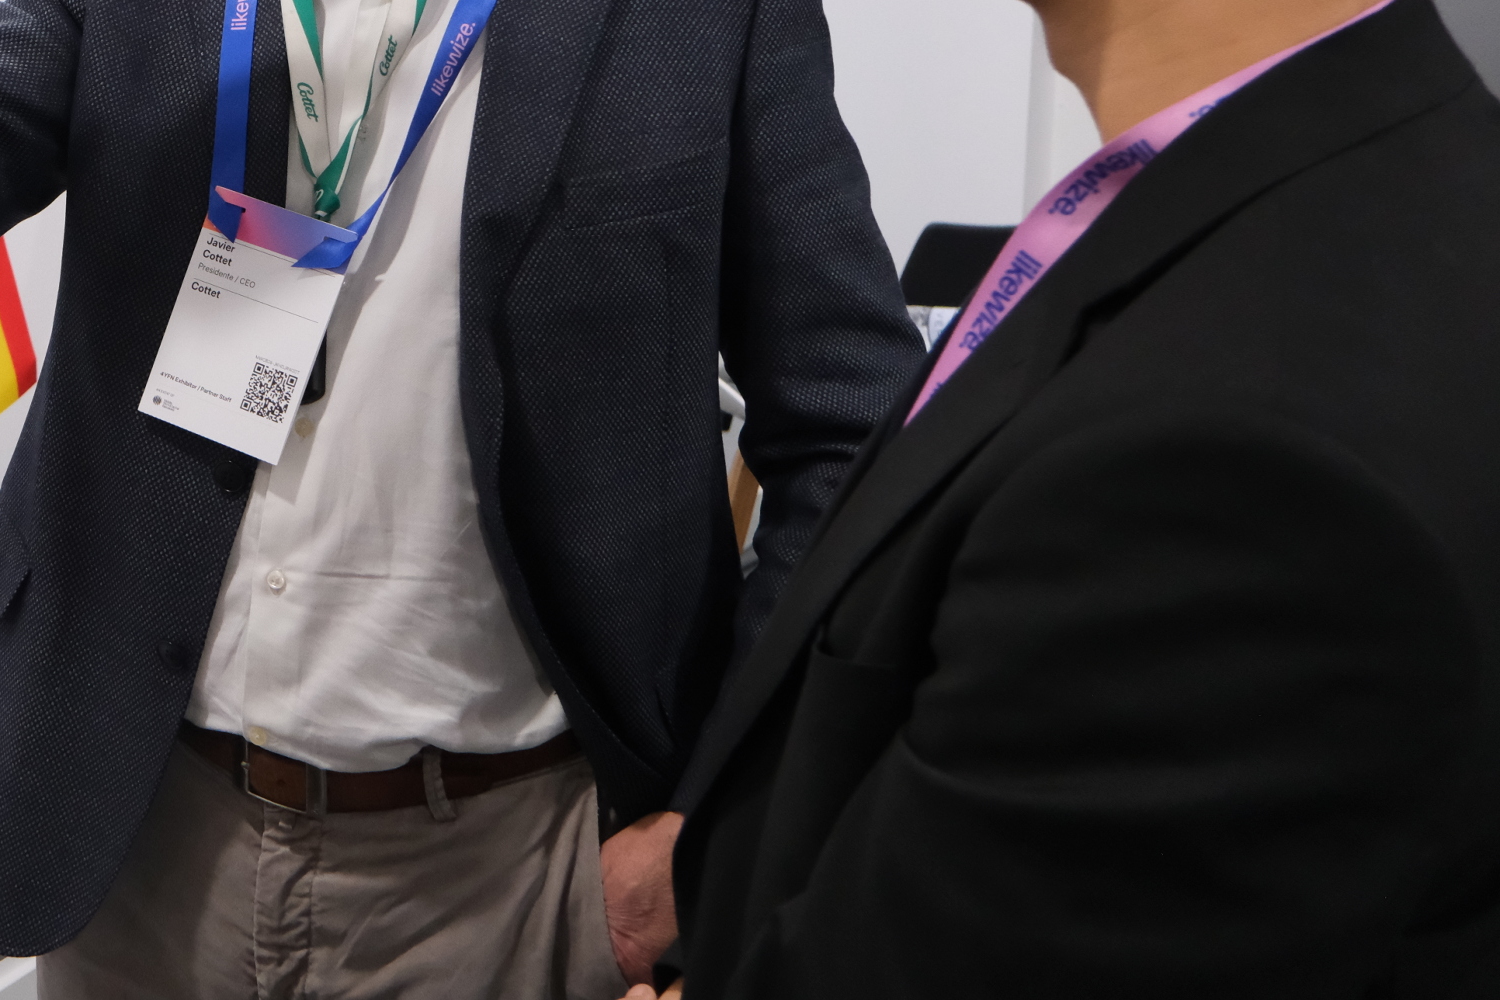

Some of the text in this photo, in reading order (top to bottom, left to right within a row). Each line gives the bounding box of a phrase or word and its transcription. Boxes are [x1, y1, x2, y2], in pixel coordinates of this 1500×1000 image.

[379, 34, 398, 77] Cottet
[430, 22, 476, 97] likewize.
[297, 82, 319, 122] Cottet
[1047, 138, 1158, 216] likewize.
[203, 249, 232, 266] Cottet
[207, 237, 235, 253] Javier
[191, 281, 221, 298] Cottet
[198, 262, 234, 280] Presidente
[240, 278, 256, 288] CEO
[959, 249, 1044, 351] likewize.
[160, 371, 175, 381] 4YFN
[175, 377, 197, 389] Exhibitor
[200, 386, 218, 397] Partner
